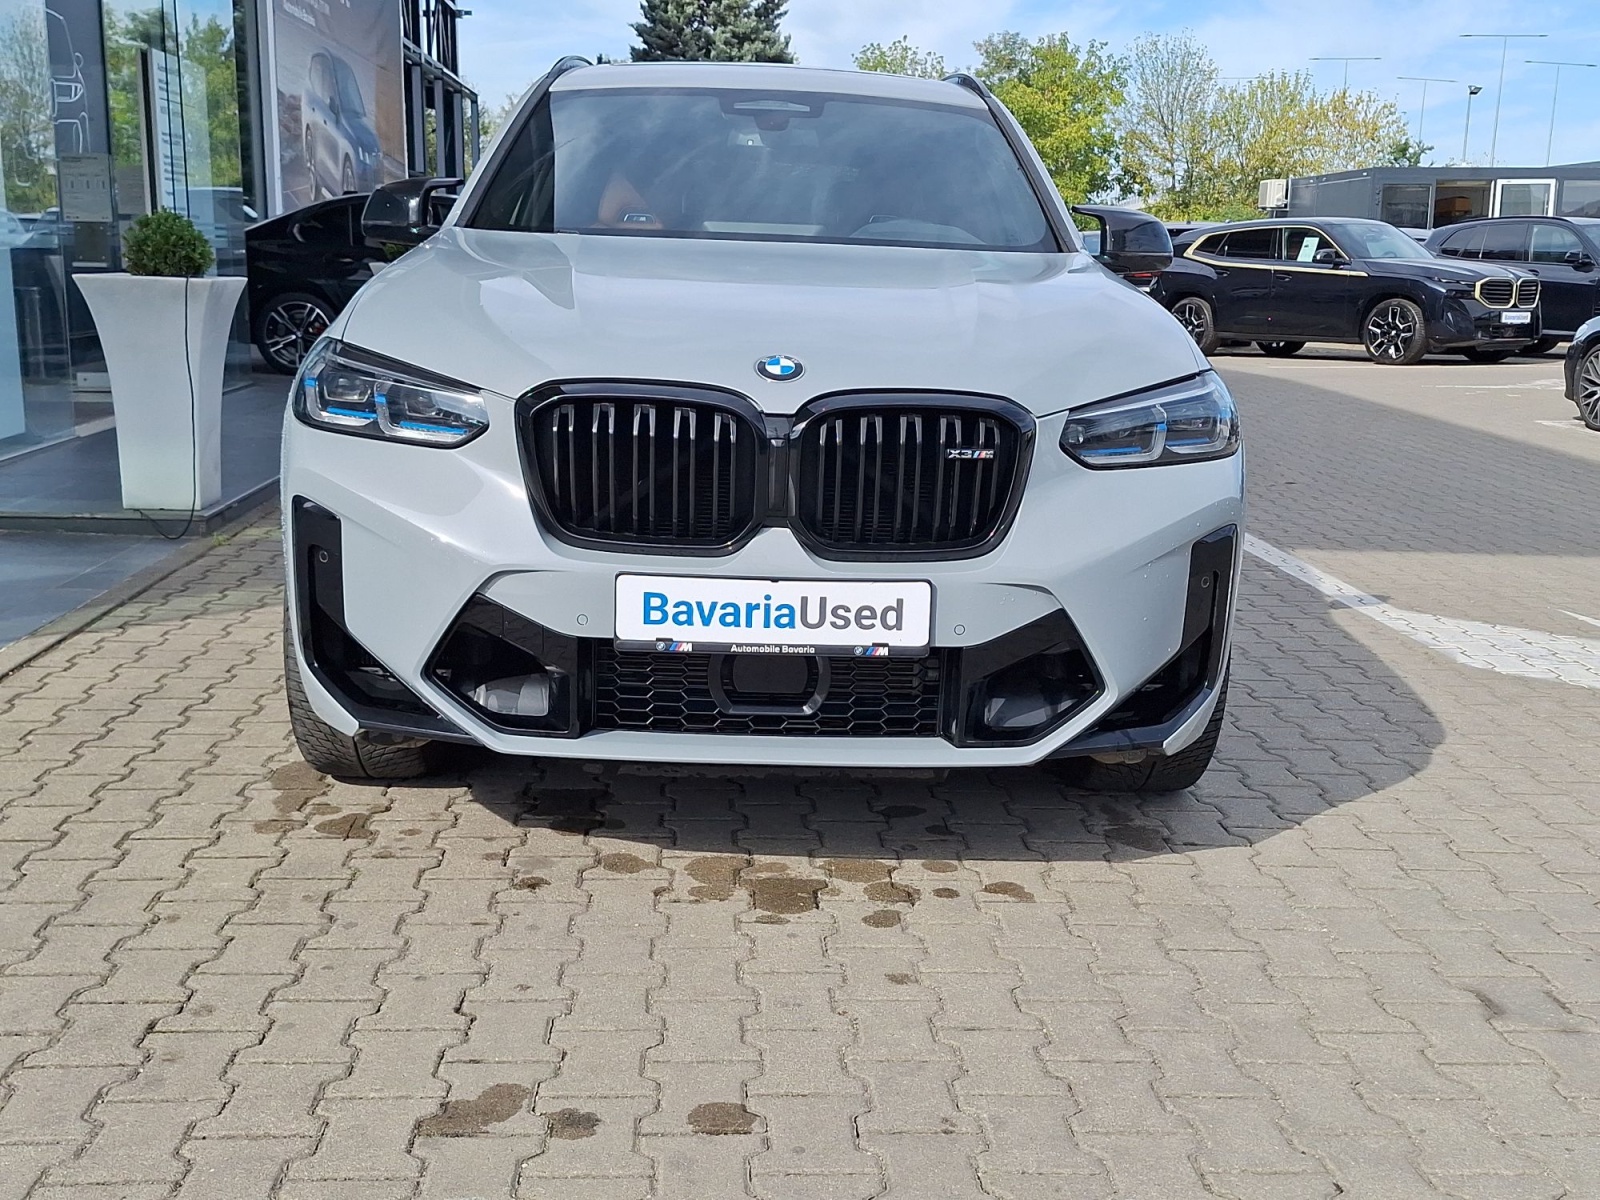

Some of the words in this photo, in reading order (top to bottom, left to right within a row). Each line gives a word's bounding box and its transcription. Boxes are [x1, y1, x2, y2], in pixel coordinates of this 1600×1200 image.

[643, 591, 904, 631] BavariaUsed
[730, 644, 780, 653] Automobile
[781, 645, 815, 654] Bavaria
